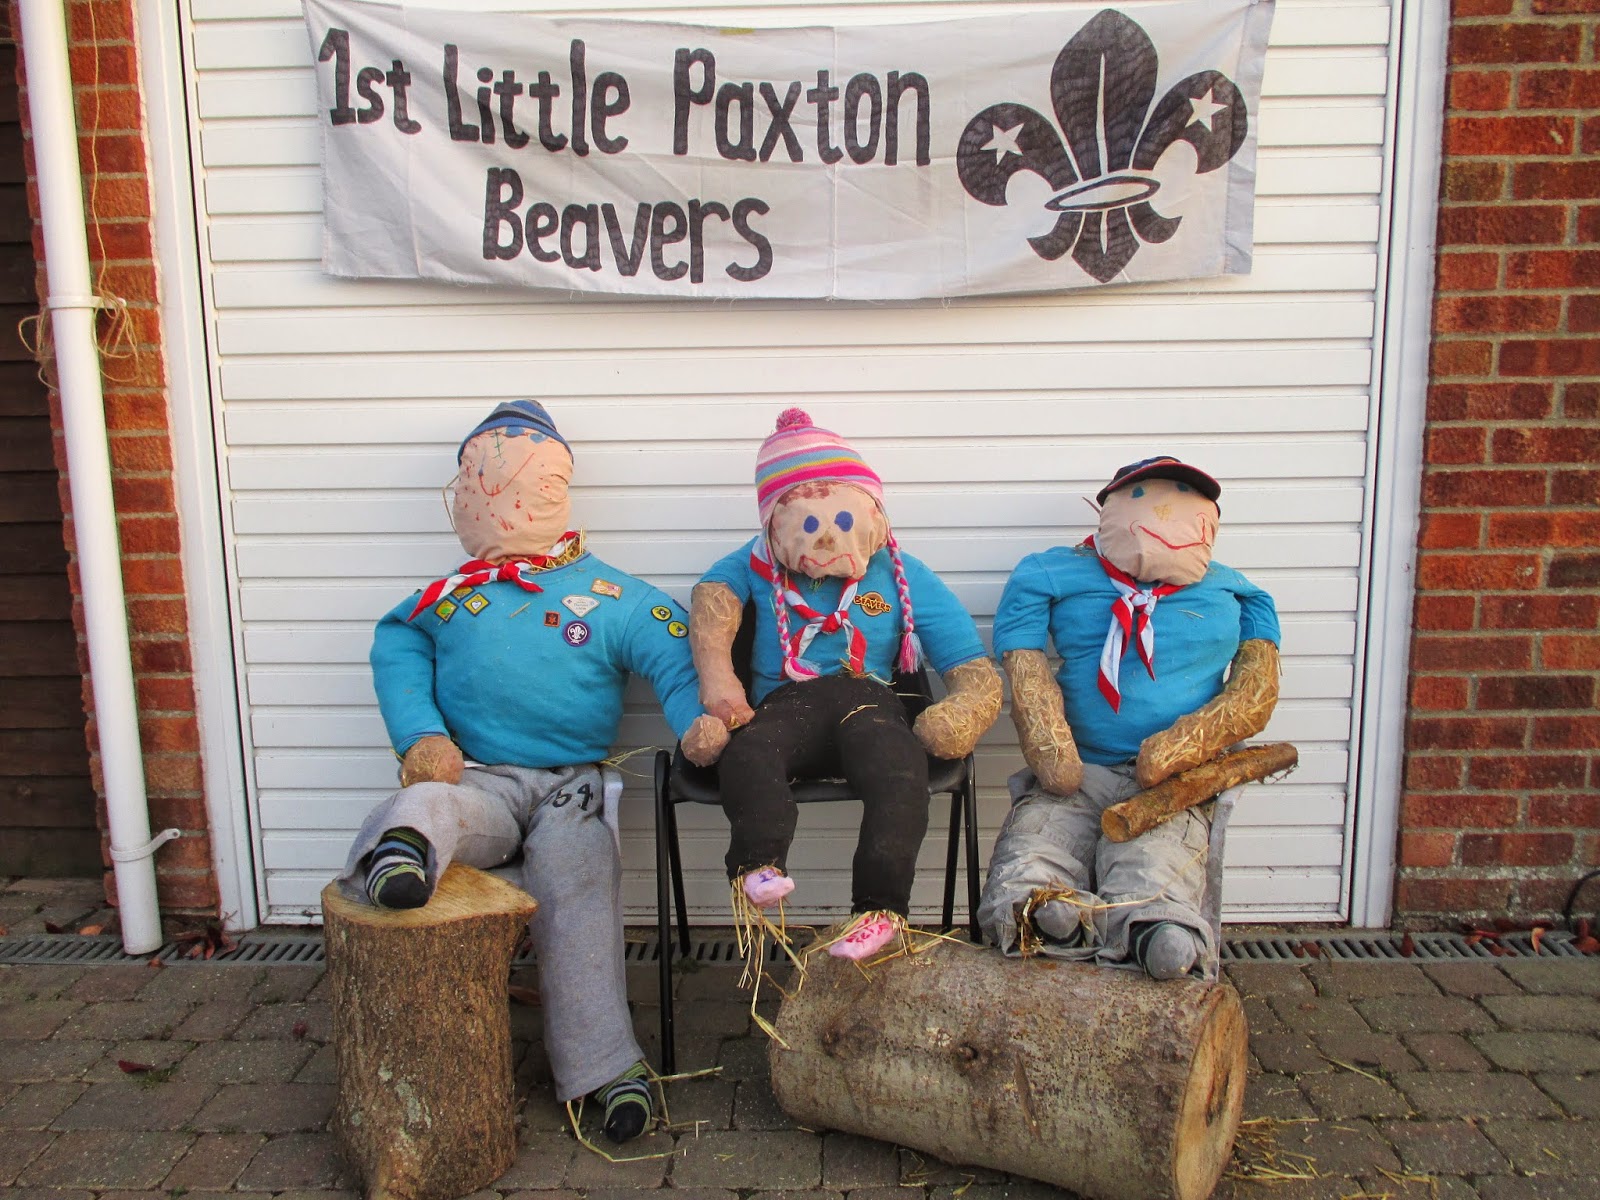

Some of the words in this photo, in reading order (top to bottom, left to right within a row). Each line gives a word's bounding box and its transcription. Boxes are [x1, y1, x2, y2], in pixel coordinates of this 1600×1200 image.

[317, 27, 422, 135] 1st
[442, 39, 632, 158] Little
[673, 47, 931, 167] Paxton
[482, 167, 773, 284] Beavers
[854, 595, 891, 611] BEAVERS
